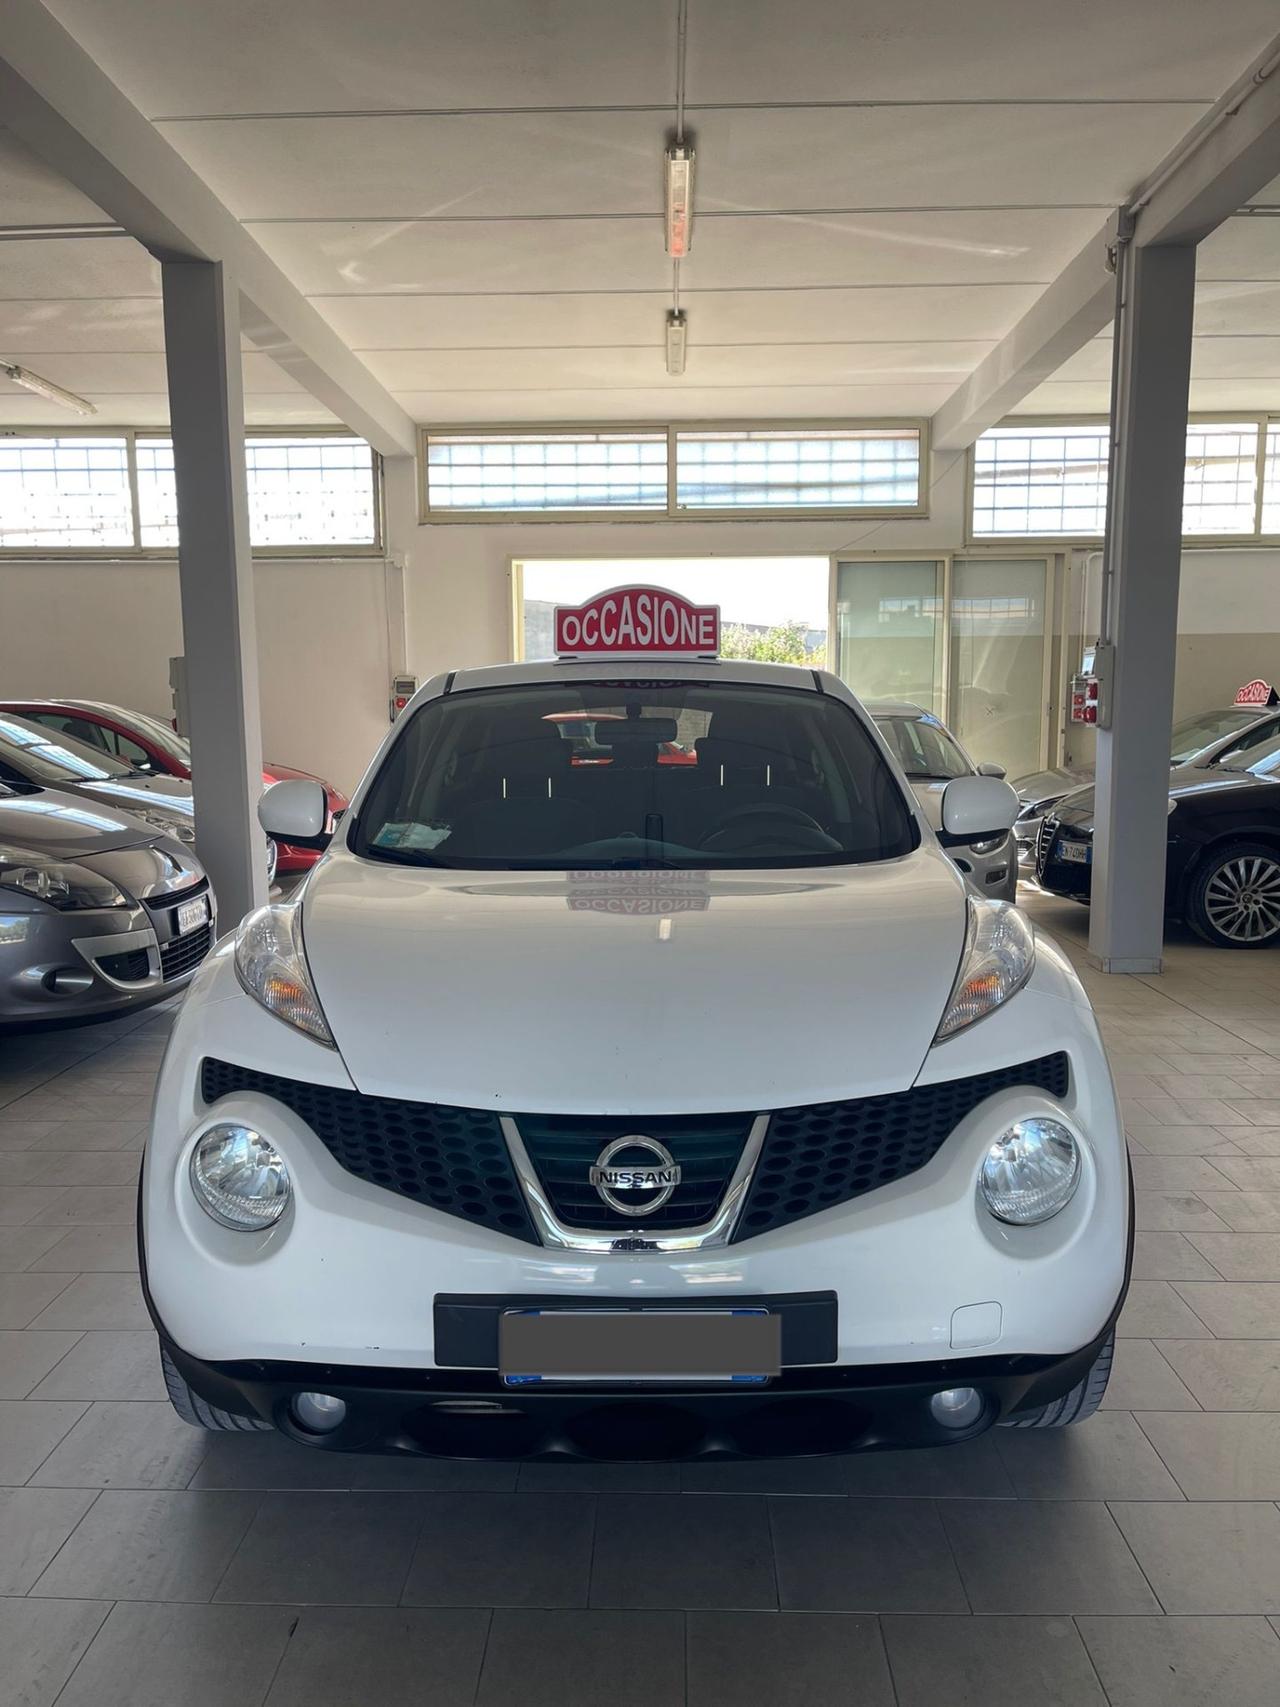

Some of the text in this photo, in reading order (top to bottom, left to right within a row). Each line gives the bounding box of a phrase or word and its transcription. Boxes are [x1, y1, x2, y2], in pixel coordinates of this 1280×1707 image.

[562, 594, 714, 646] OCCASIONE
[1236, 683, 1270, 702] OCCASIONE
[600, 1171, 672, 1184] NISSAN
